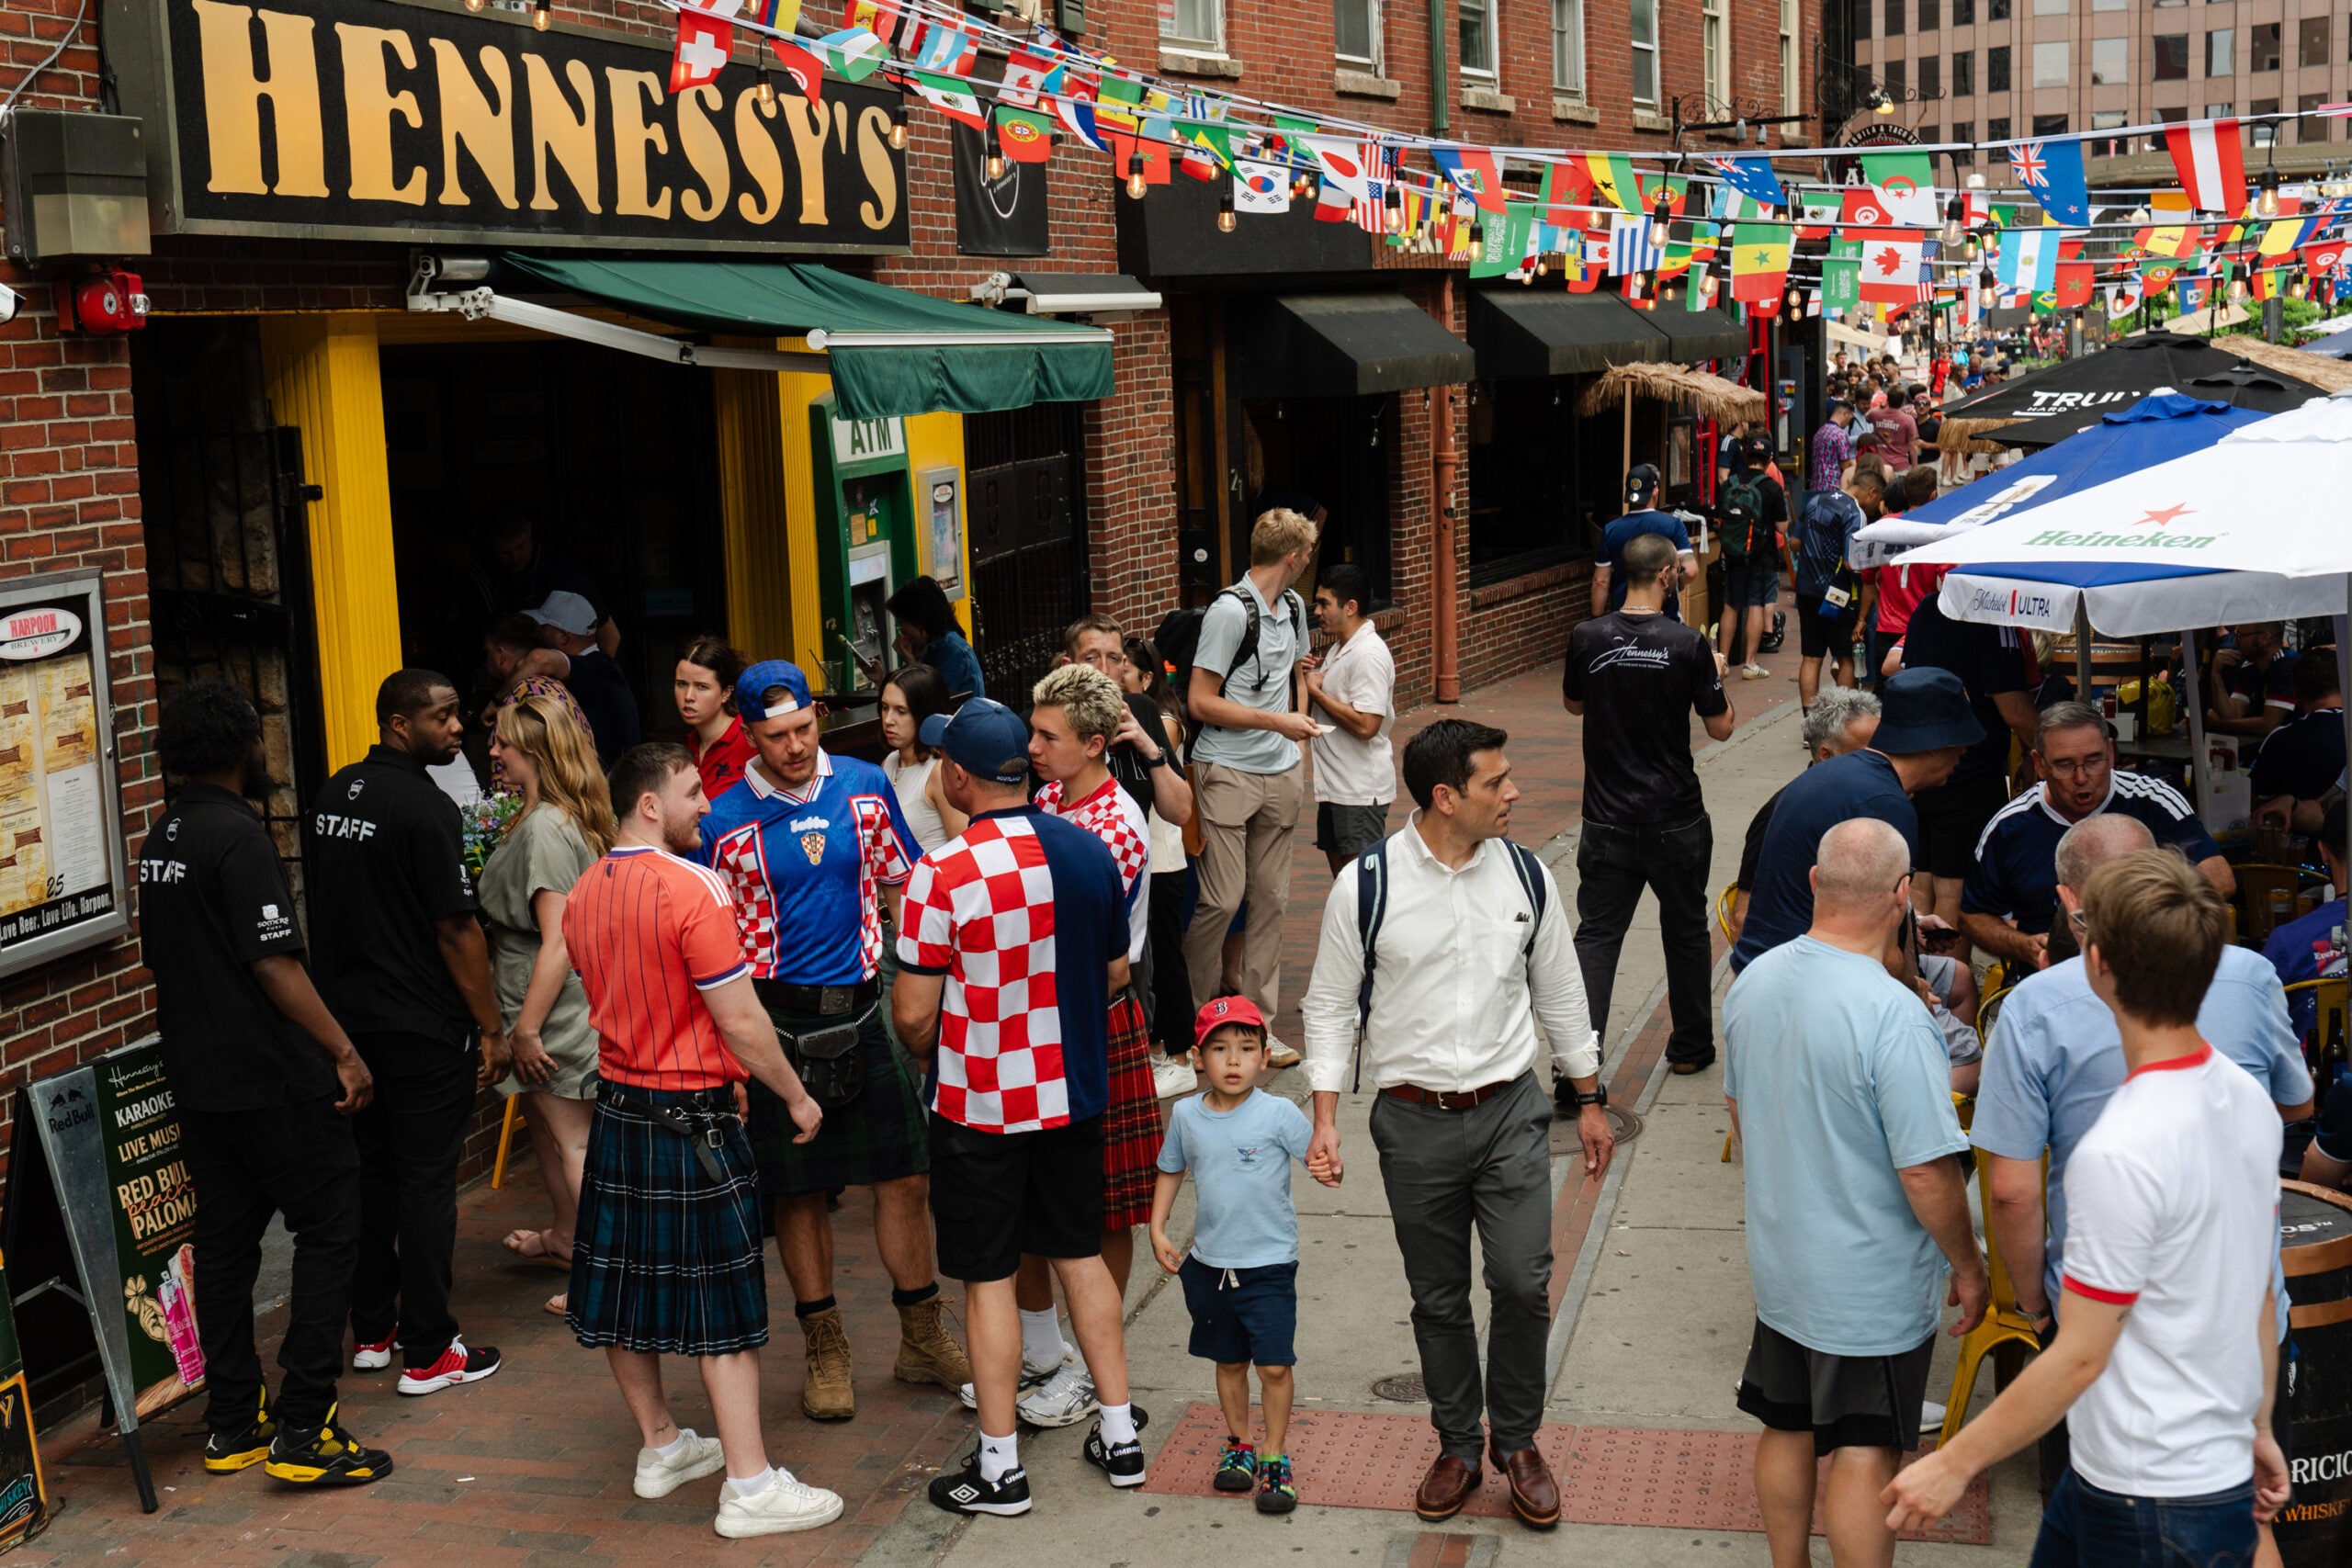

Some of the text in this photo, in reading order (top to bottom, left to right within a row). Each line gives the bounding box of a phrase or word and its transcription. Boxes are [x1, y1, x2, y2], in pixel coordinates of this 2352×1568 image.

[191, 0, 899, 230] HENNESSY'S
[1847, 126, 1876, 147] EQUILA
[1889, 125, 1908, 137] TACO
[2031, 390, 2141, 407] TRU
[851, 418, 892, 455] ATM
[2021, 530, 2217, 548] Heineken
[2018, 596, 2050, 617] ULTRA
[10, 614, 57, 638] HARPOON
[11, 636, 57, 649] BREWERY
[1589, 637, 1670, 673] Hennessy's
[316, 814, 377, 841] STAFF
[140, 859, 187, 885] STAFF
[47, 874, 64, 898] 25
[41, 909, 60, 927] Love
[62, 900, 78, 920] Life.
[80, 893, 111, 914] Harpoon.
[260, 929, 292, 942] STAFF
[1214, 1001, 1228, 1017] B
[49, 1103, 95, 1134] Red Bull
[115, 1090, 175, 1128] KARAOKE
[118, 1135, 149, 1163] LIVE
[117, 1175, 154, 1209] RED
[1114, 1446, 1141, 1457] UMBRO
